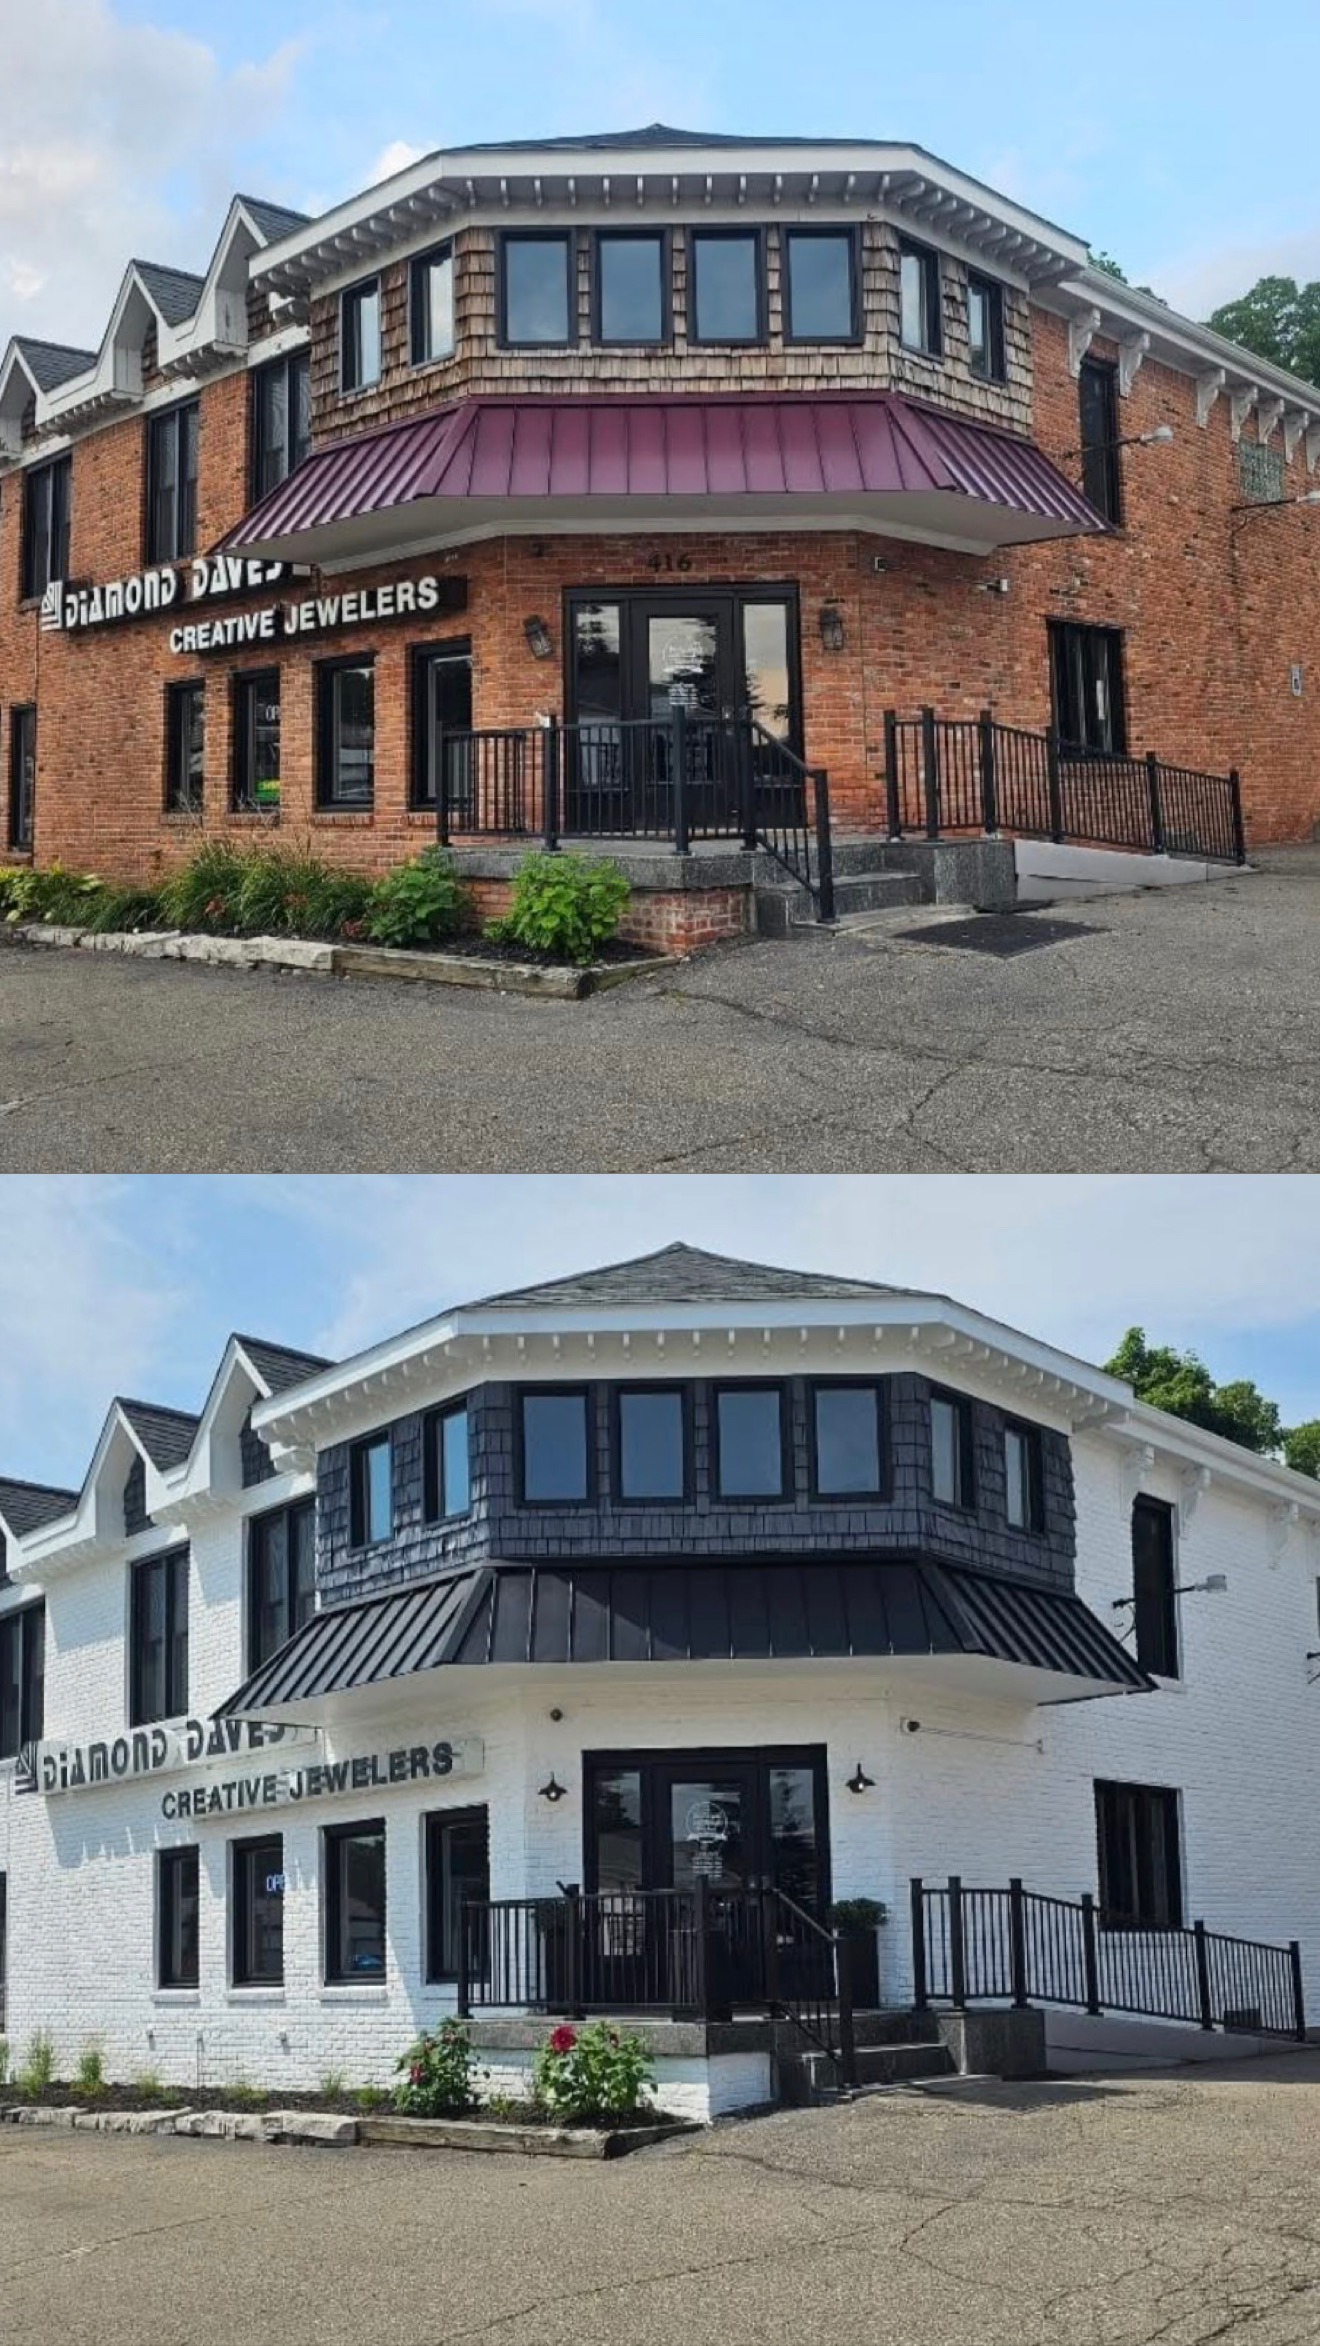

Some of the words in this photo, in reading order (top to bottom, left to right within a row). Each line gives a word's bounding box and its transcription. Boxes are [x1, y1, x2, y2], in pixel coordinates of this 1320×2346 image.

[169, 608, 276, 654] CREATIVE
[284, 576, 439, 635] JEWELERS
[162, 1773, 278, 1820] CREATIVE
[289, 1741, 453, 1800] JEWELERS
